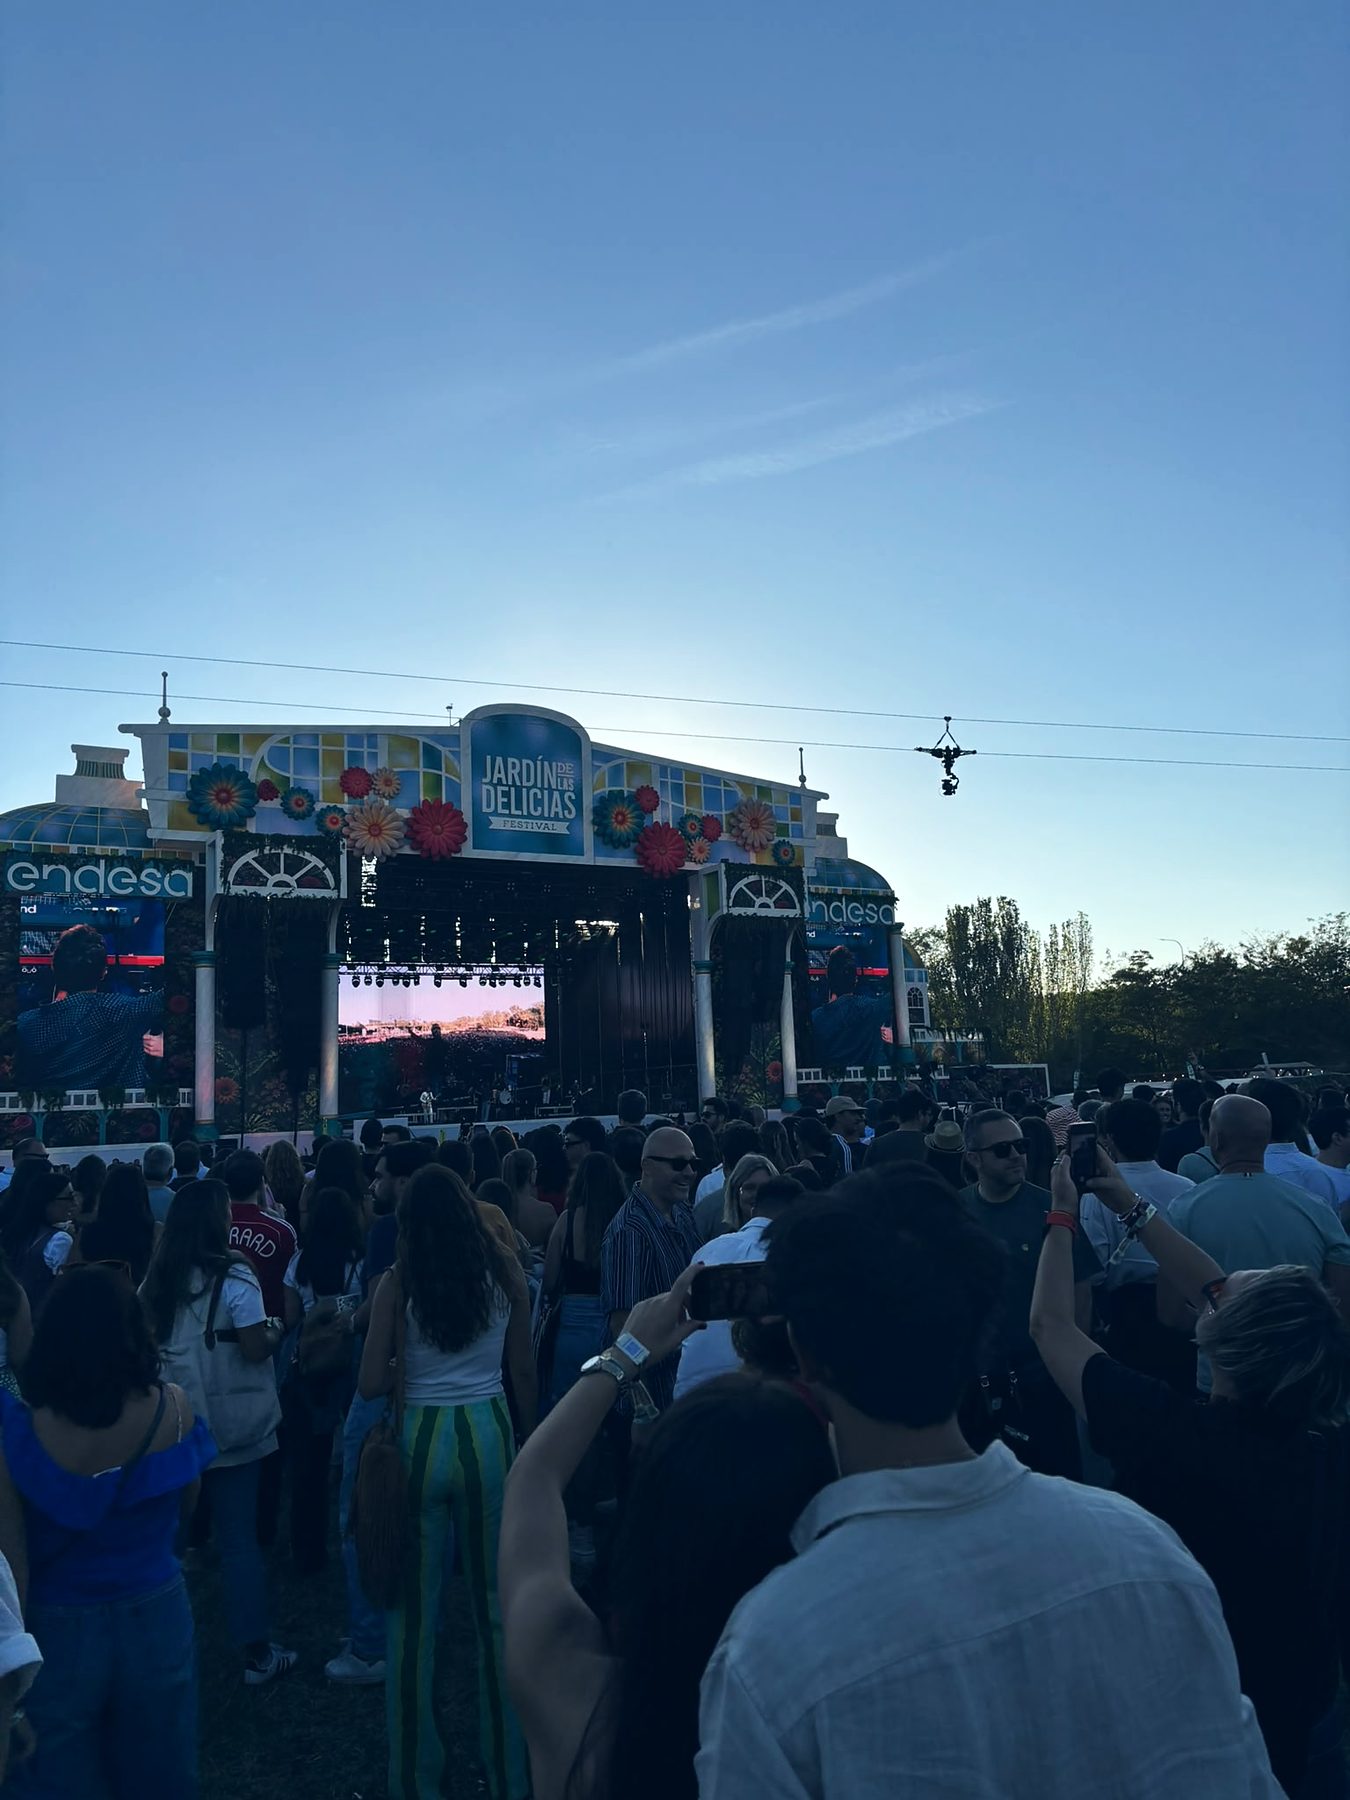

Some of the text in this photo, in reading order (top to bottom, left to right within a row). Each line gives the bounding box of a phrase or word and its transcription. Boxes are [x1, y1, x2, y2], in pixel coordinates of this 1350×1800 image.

[482, 755, 557, 789] JARDÍN
[557, 762, 574, 774] DE
[558, 778, 575, 791] LAS
[482, 784, 576, 819] DELICIAS
[503, 820, 557, 831] FESTIVAL
[7, 859, 193, 897] endesa
[812, 896, 895, 925] ndesa
[229, 1226, 276, 1258] RARD
